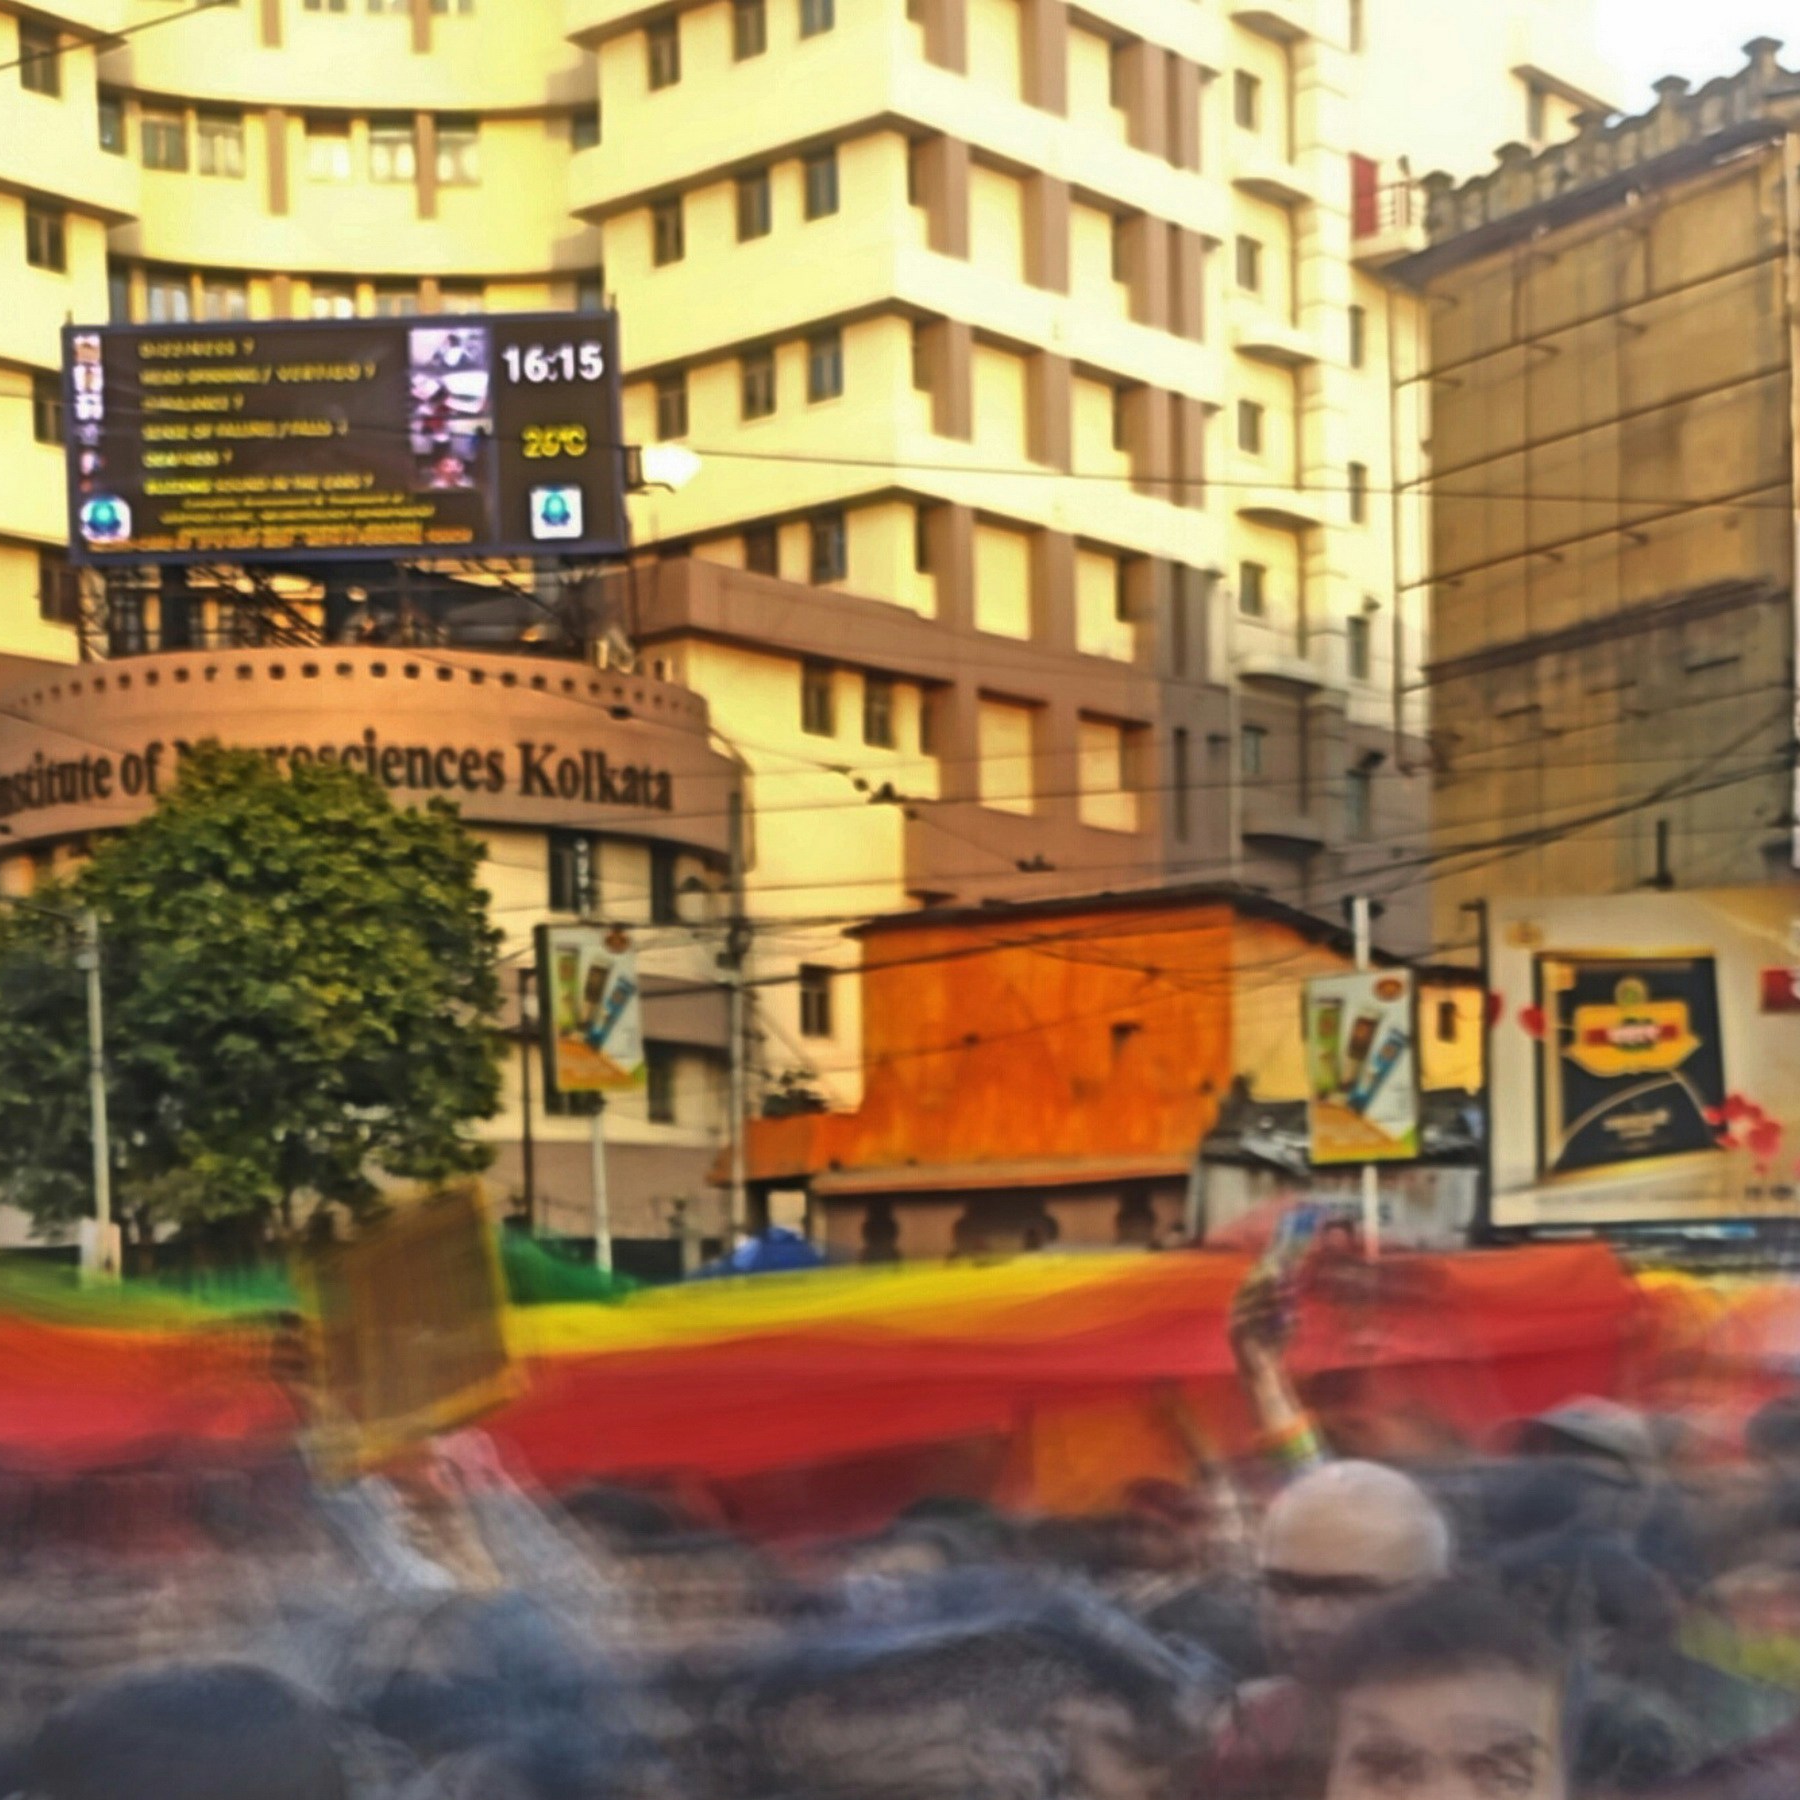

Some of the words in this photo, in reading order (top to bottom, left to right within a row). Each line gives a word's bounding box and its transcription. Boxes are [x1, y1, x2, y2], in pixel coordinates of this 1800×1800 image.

[502, 340, 604, 383] 16:15
[119, 740, 165, 797] of
[515, 741, 673, 811] Kolkata
